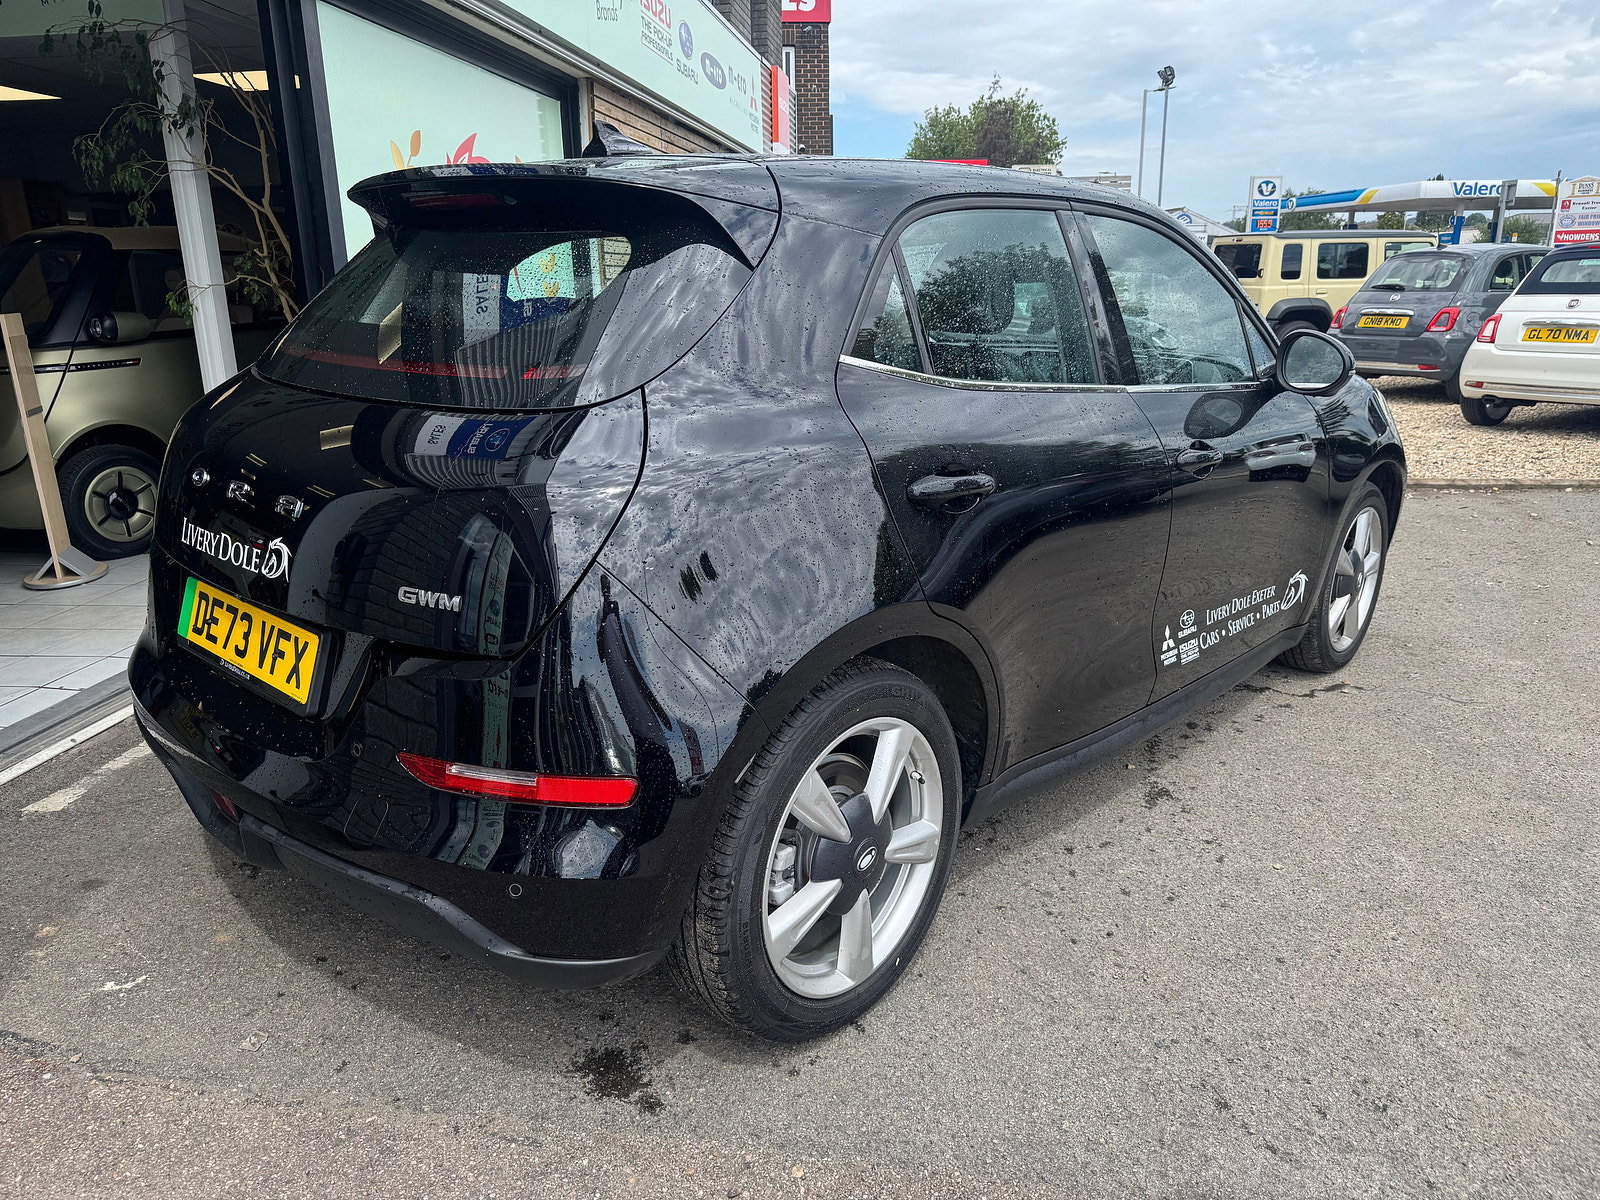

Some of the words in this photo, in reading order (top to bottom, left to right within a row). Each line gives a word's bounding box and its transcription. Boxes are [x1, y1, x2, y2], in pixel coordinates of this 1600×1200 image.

[640, 0, 672, 29] SUZU
[676, 58, 698, 85] SUBARU
[1564, 233, 1599, 241] HOWDENS
[1563, 329, 1590, 341] NMA
[398, 586, 463, 613] GWM
[1206, 603, 1231, 626] LIVERY
[1232, 595, 1251, 614] DOLE
[1251, 585, 1276, 605] EXETER
[1178, 625, 1197, 639] SUBARU
[1200, 629, 1220, 649] CARS
[1228, 612, 1255, 636] SERVICE
[1262, 601, 1281, 619] PARTS
[192, 590, 253, 659] DE73
[258, 620, 310, 690] VFX
[1179, 638, 1199, 653] ISUZU
